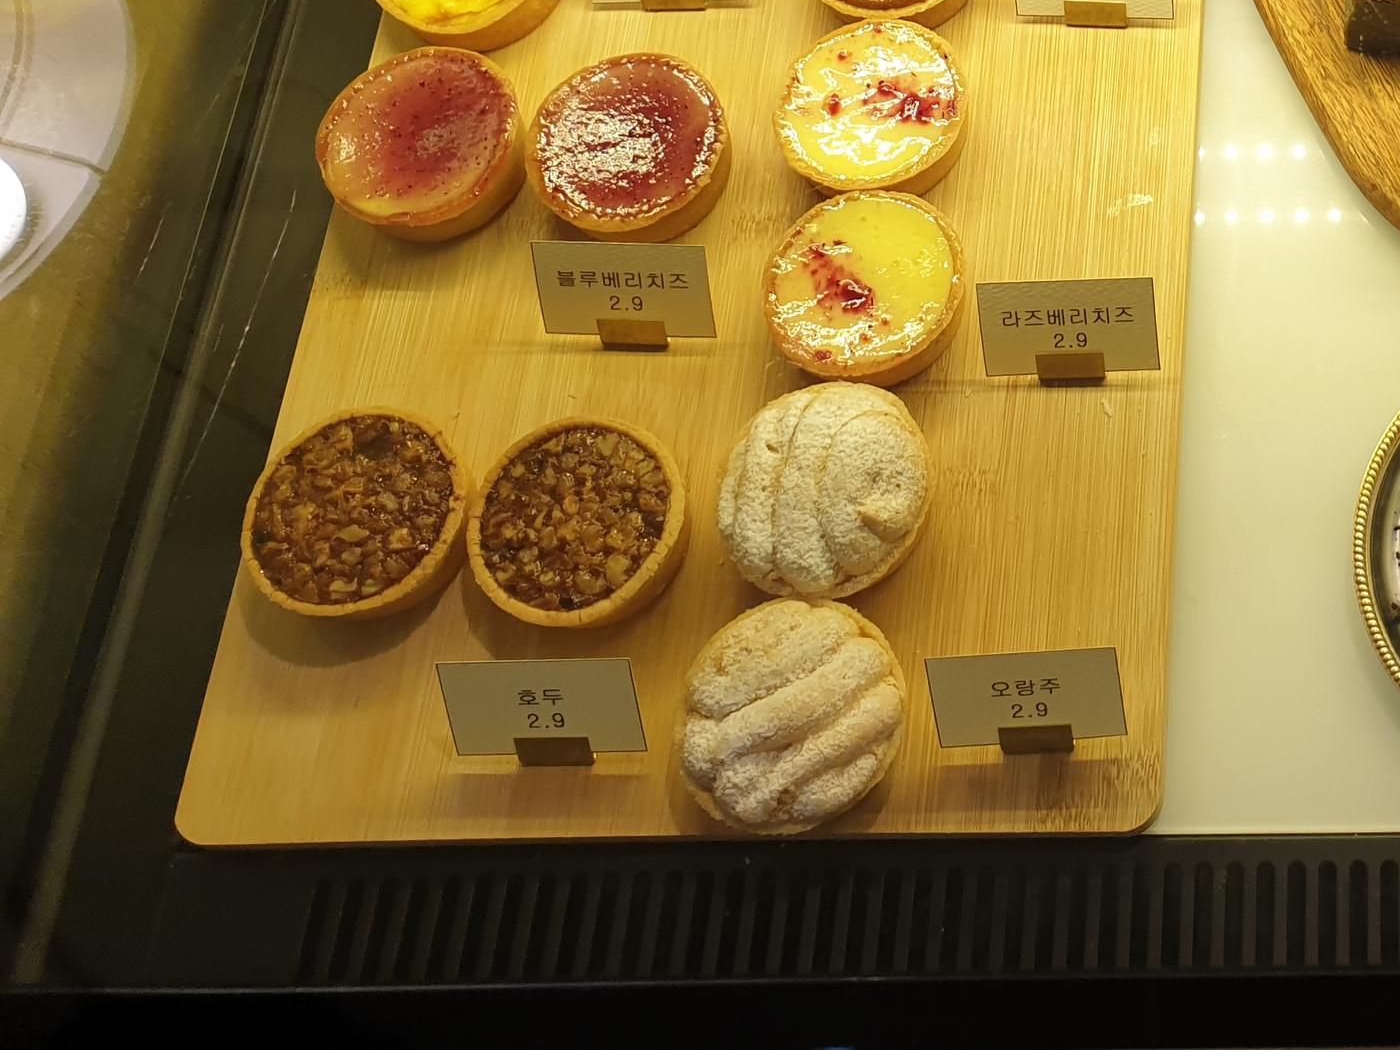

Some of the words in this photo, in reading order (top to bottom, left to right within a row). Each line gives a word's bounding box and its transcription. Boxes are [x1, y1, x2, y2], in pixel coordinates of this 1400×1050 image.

[556, 270, 689, 290] 블루베리치즈
[609, 295, 644, 312] 2.9
[1001, 306, 1134, 328] 라즈베리치즈
[1053, 332, 1088, 349] 2.9
[991, 678, 1060, 698] 오랑주
[518, 688, 563, 707] 호두
[1010, 701, 1048, 719] 2.9
[527, 712, 565, 729] 2.9
